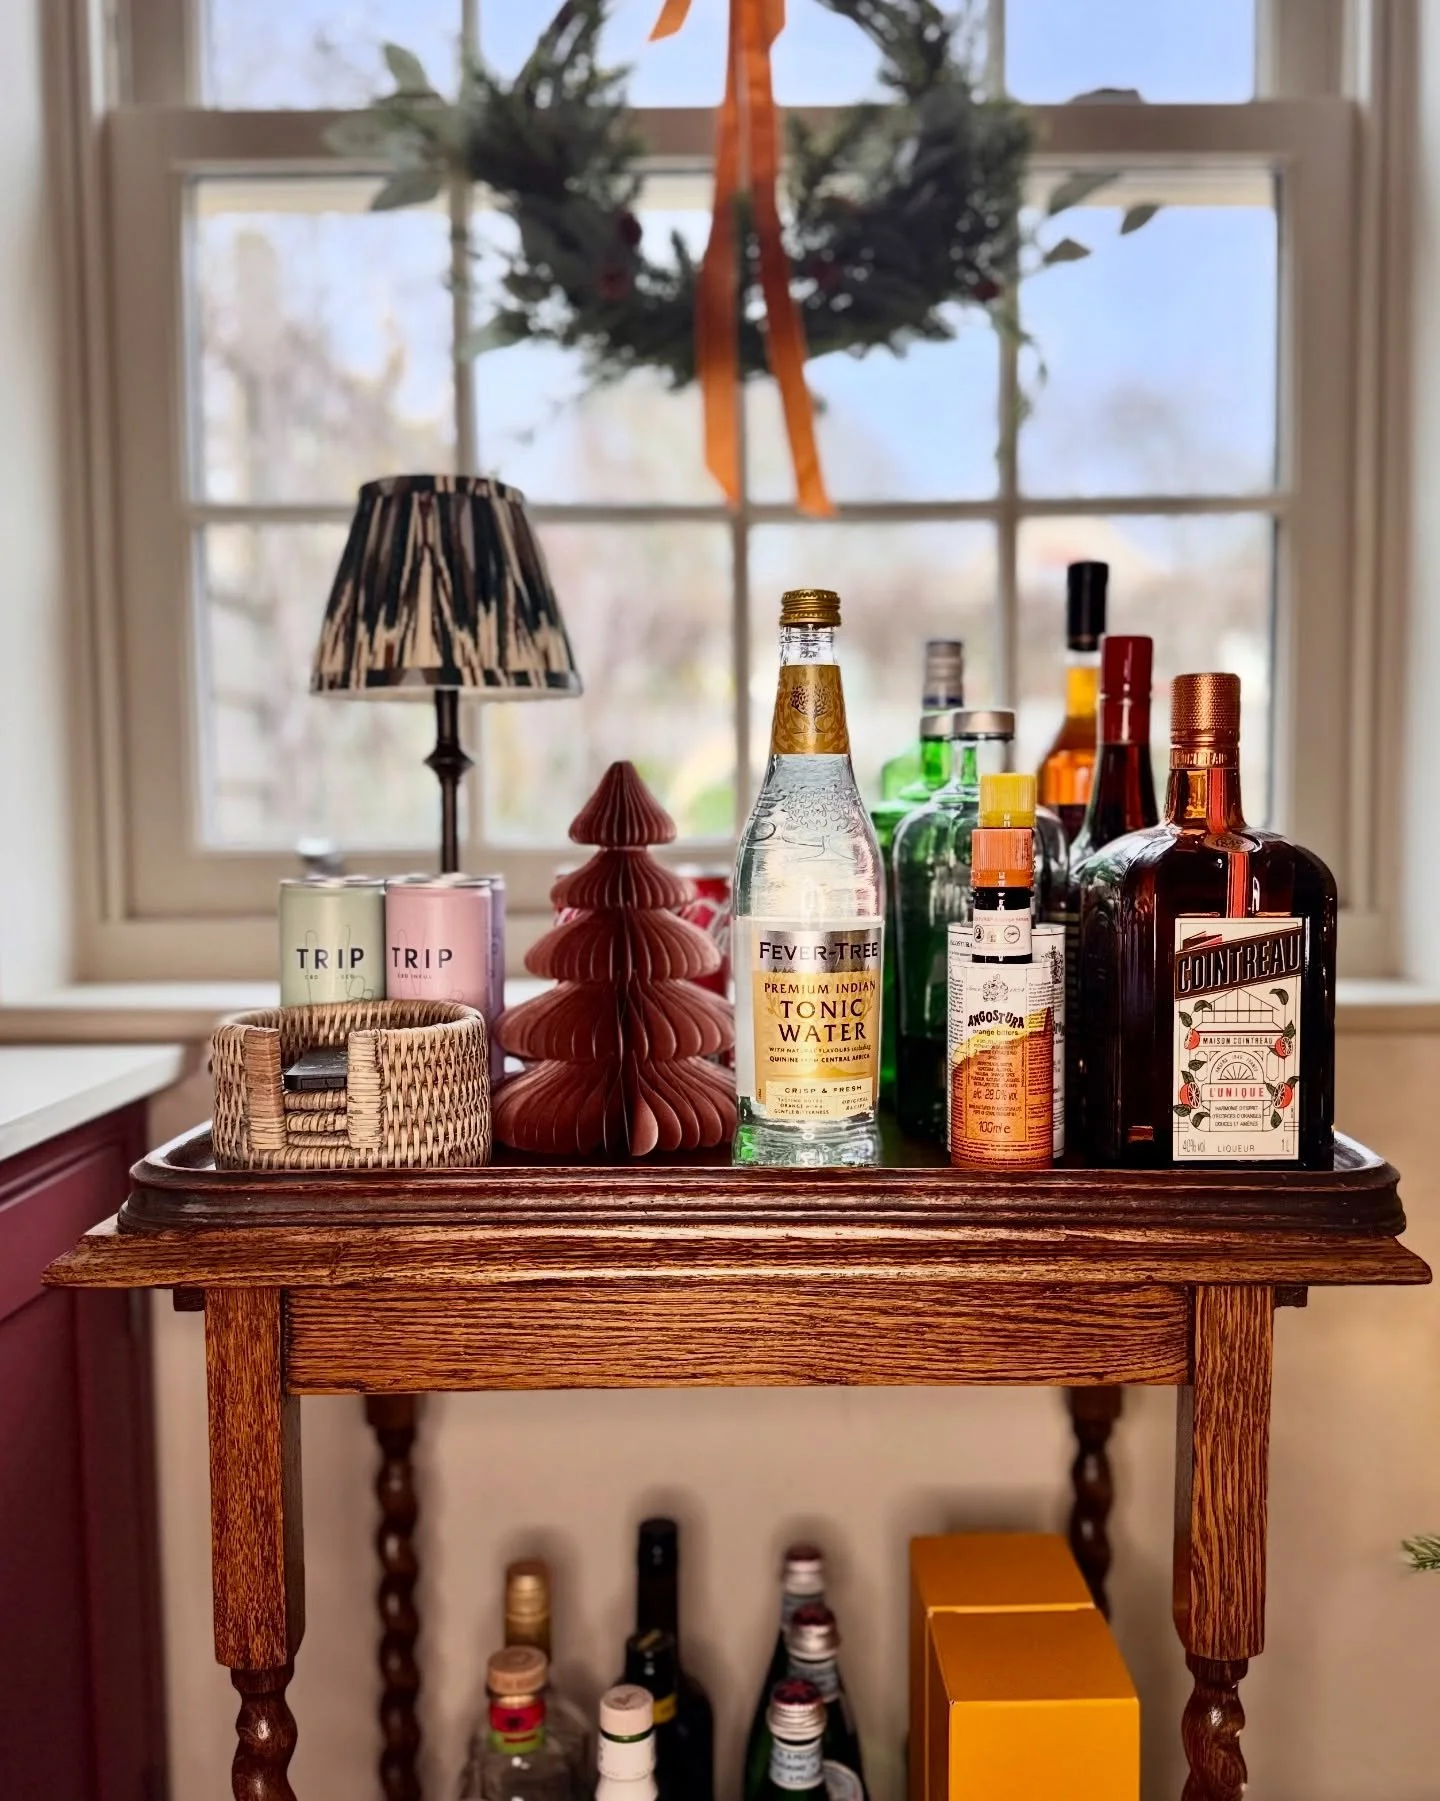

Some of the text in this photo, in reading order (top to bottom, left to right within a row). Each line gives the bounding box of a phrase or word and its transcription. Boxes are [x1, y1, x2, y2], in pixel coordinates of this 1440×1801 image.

[296, 947, 364, 969] TRIP
[392, 947, 453, 969] TRIP
[760, 941, 878, 961] FEVER-TREE
[1177, 934, 1301, 994] COINTREAU
[764, 980, 876, 995] PREMIUM INDIAN
[780, 998, 863, 1019] TONIC
[968, 1010, 1024, 1029] ANGOSTURA
[778, 1022, 866, 1042] WATER
[1203, 1037, 1273, 1045] MAISON COINTREAU
[769, 1055, 799, 1063] QUININE
[833, 1085, 862, 1094] FRESH
[1209, 1087, 1264, 1099] L'UNIQUE
[1217, 1144, 1255, 1153] LIQUEUR
